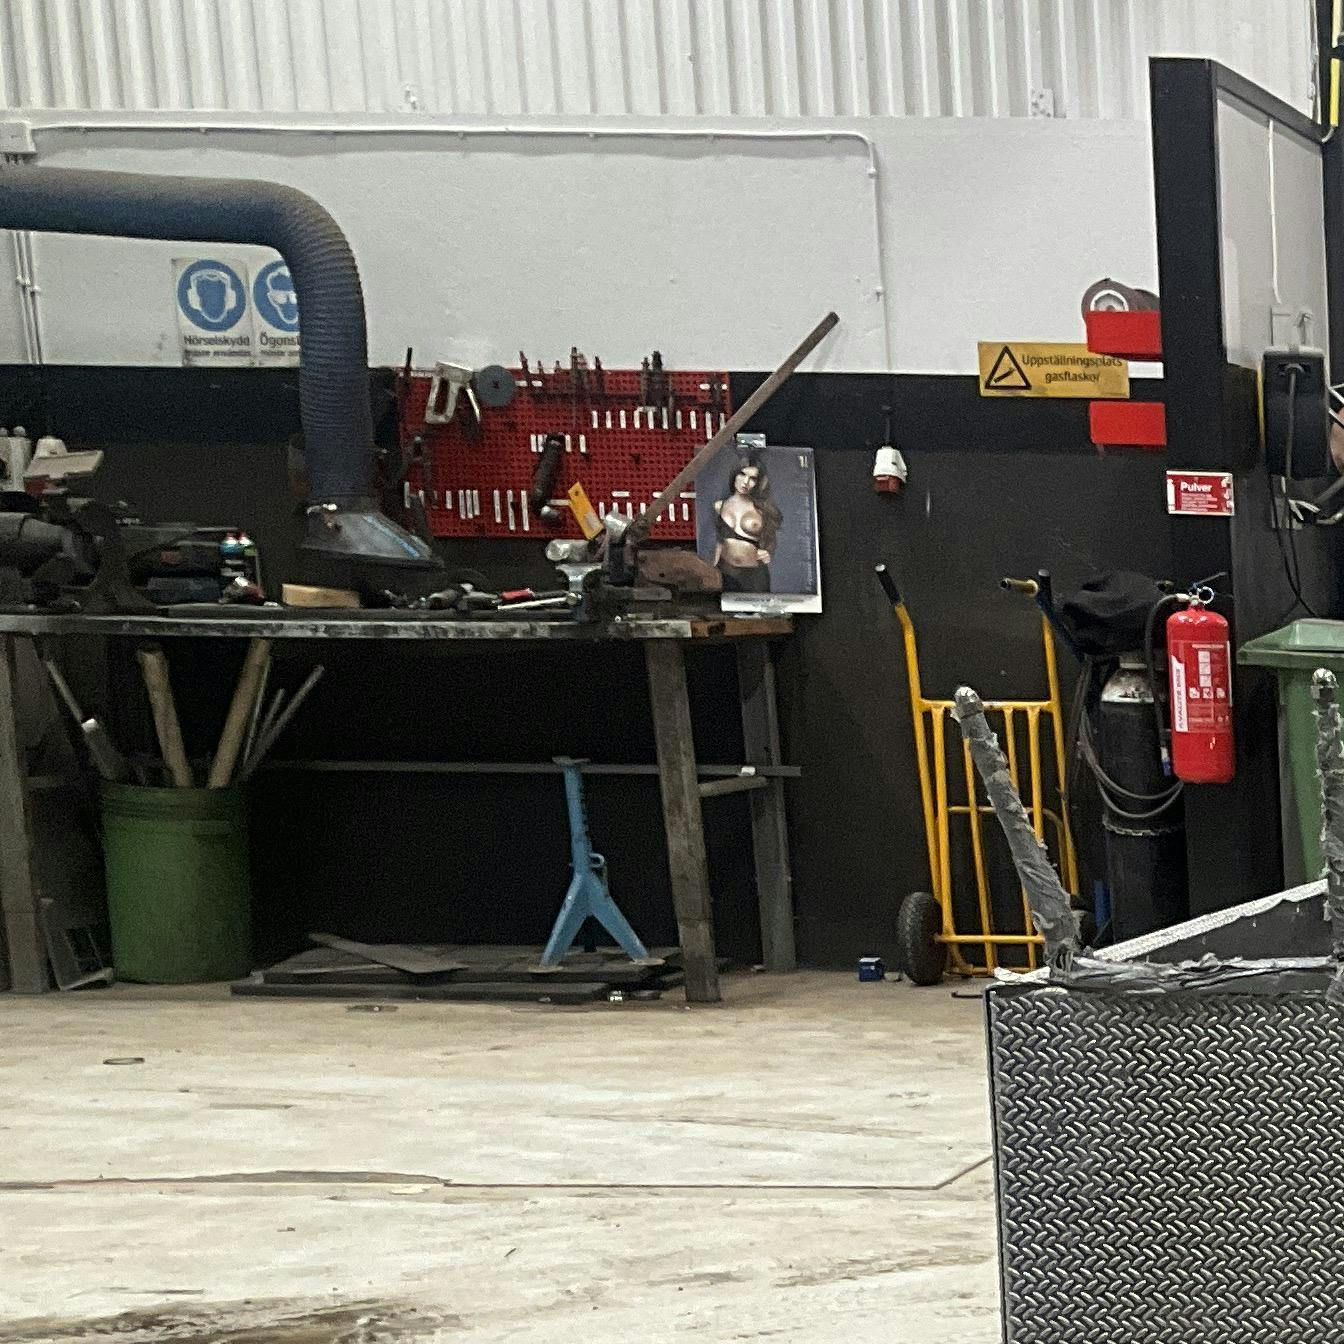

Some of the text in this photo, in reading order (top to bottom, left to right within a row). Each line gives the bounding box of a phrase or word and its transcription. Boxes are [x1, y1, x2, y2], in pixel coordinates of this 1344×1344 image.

[183, 335, 250, 346] Hörselskydd
[1022, 354, 1123, 367] Uppställningsplats
[1180, 481, 1212, 492] Pulver
